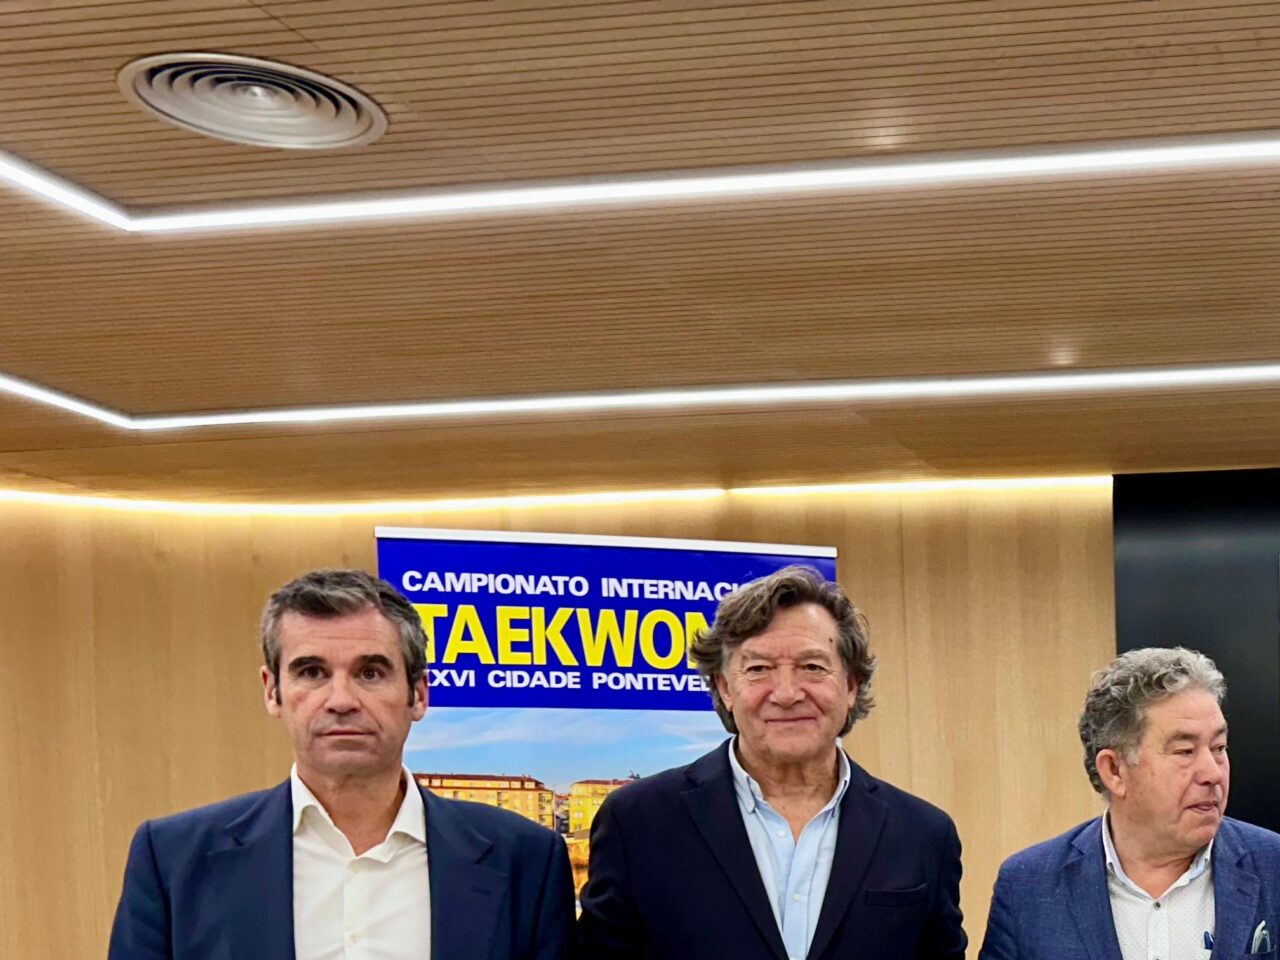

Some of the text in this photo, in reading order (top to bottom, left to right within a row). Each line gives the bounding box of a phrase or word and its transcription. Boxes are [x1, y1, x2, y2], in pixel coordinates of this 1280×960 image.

[401, 570, 745, 601] CAMPIONATO INTERNAC
[488, 669, 581, 689] CIDADE
[592, 673, 710, 692] PONTEVE
